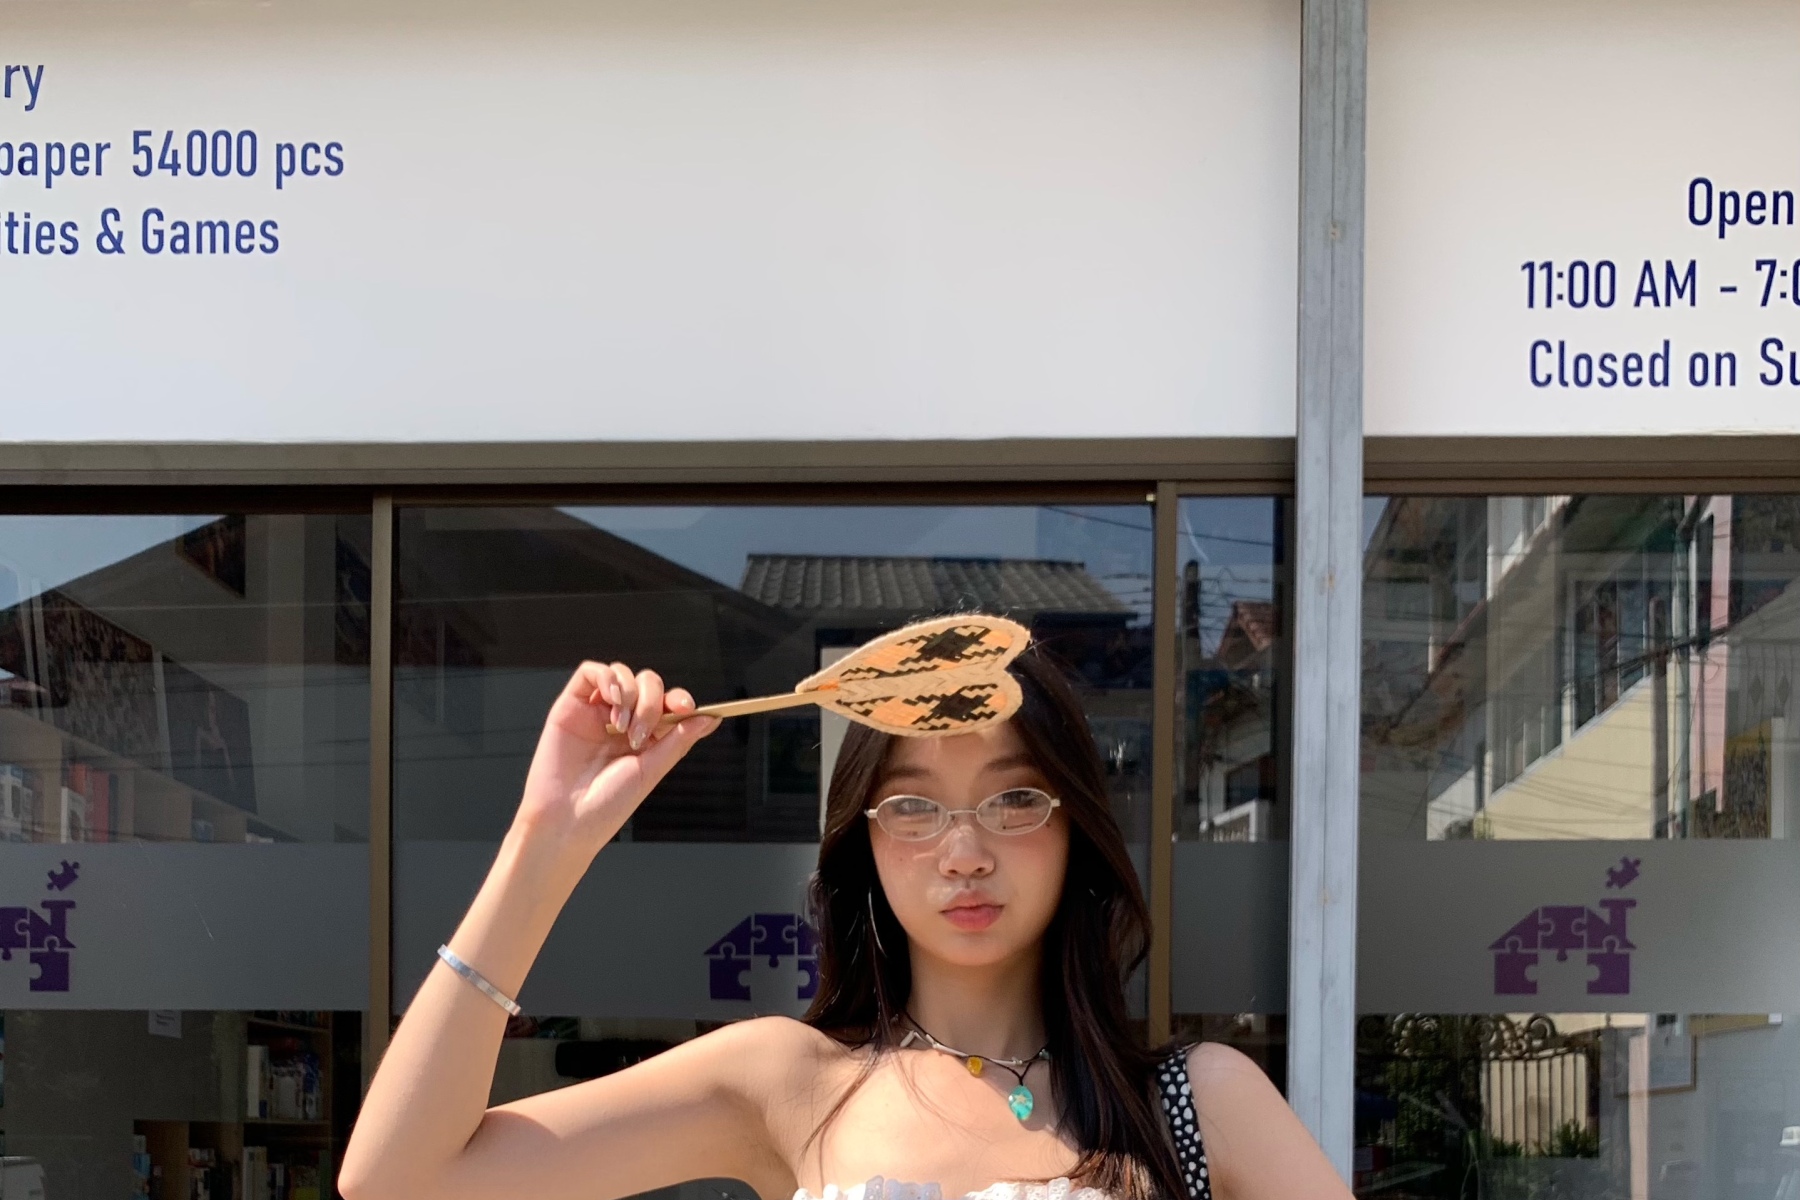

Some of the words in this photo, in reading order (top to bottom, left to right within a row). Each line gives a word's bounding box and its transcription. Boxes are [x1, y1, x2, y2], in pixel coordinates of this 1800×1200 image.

[132, 129, 257, 177] 54000
[275, 141, 345, 190] pcs
[0, 211, 79, 255] ties
[95, 207, 126, 254] &
[141, 207, 280, 254] Games
[1688, 176, 1795, 239] Open
[1520, 260, 1616, 309] 11:00
[1633, 259, 1697, 307] AM
[1529, 339, 1670, 388] Closed
[1688, 351, 1737, 387] on
